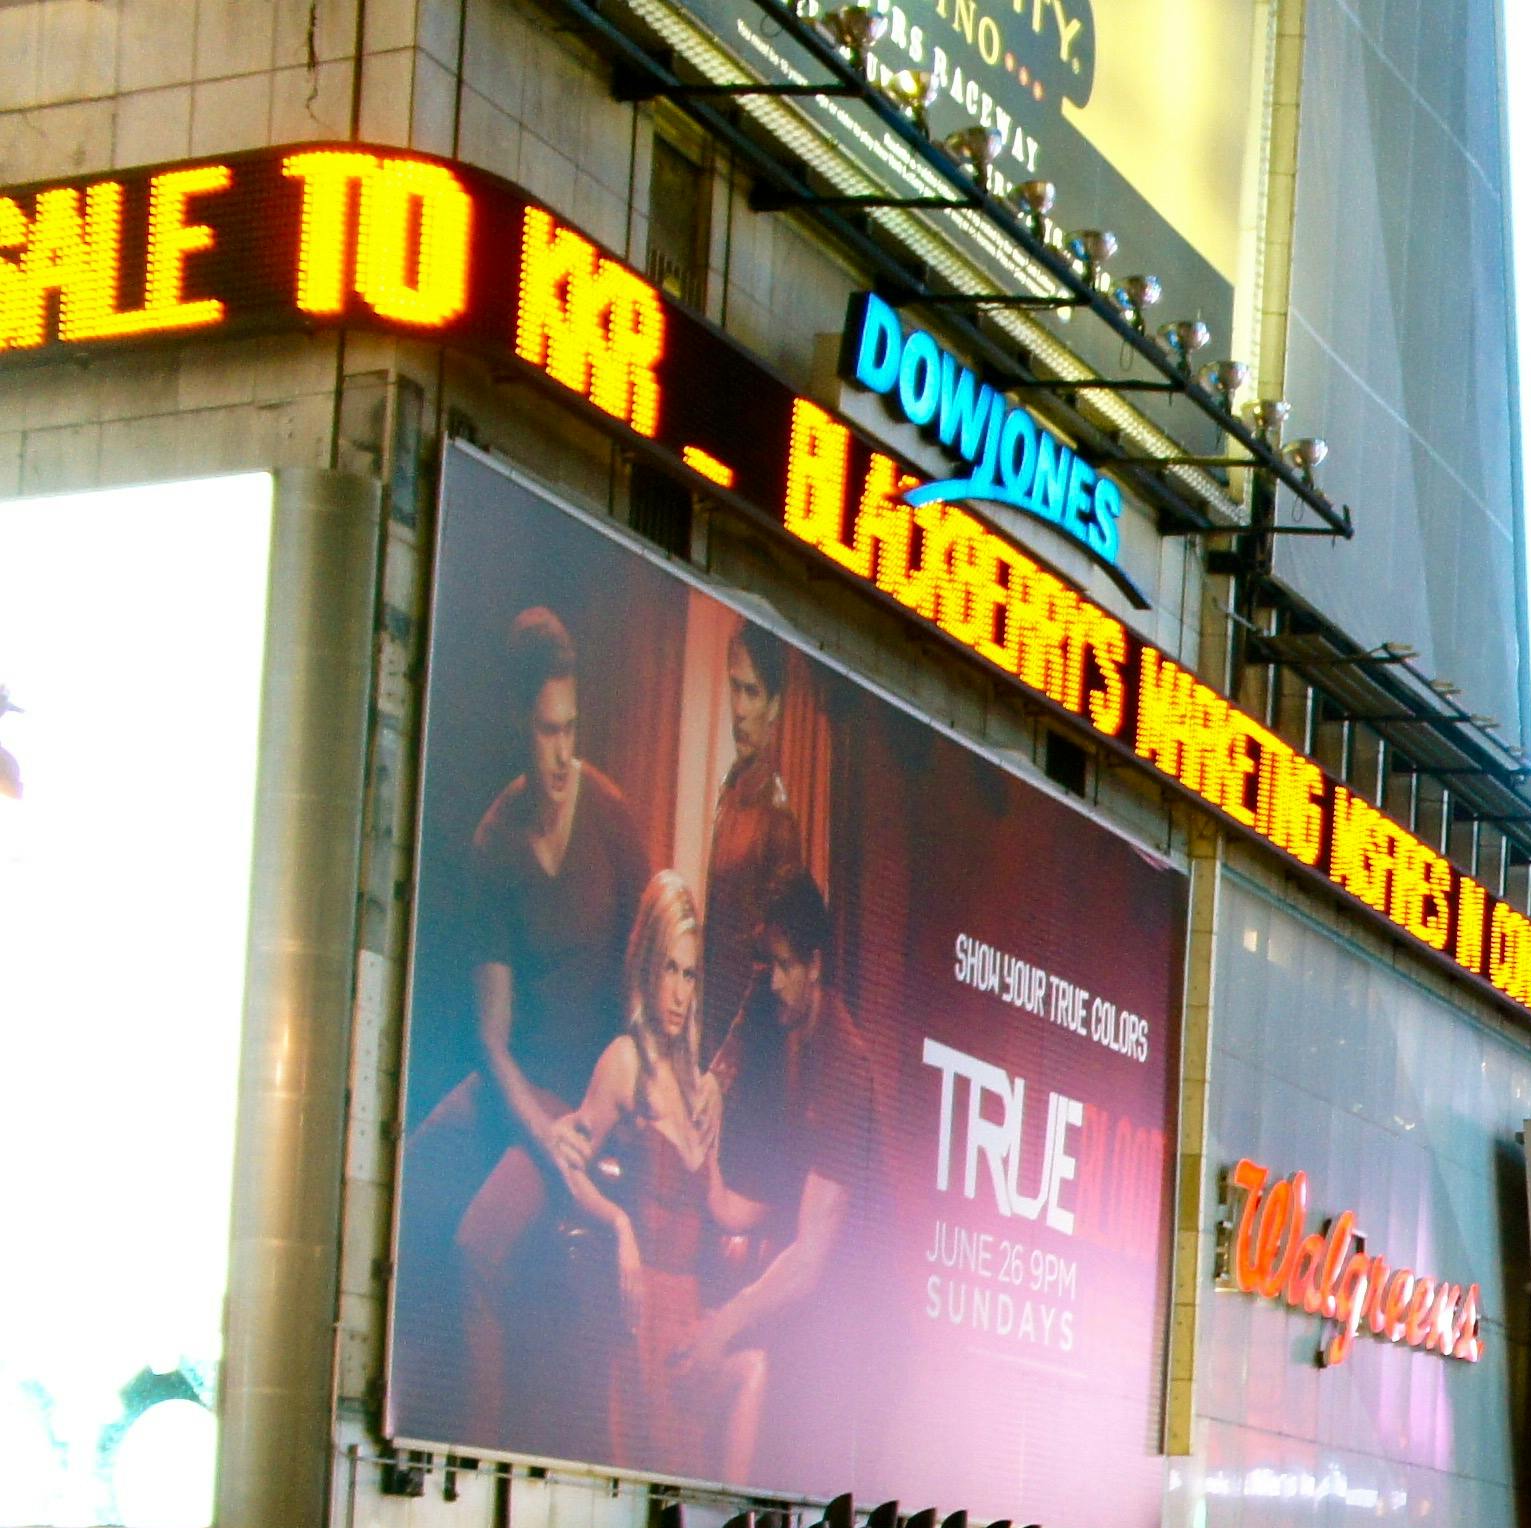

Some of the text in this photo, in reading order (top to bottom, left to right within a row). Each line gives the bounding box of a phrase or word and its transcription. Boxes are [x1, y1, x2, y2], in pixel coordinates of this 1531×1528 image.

[281, 148, 474, 330] TO
[515, 204, 666, 438] KKR
[954, 932, 1149, 1064] SHOW YOUR TRUE COLORS
[922, 1036, 1085, 1236] TRUE
[926, 1220, 1079, 1300] JUNE 26 9PM
[926, 1274, 1075, 1352] SUNDAYS
[1234, 1157, 1486, 1366] Walgreens
